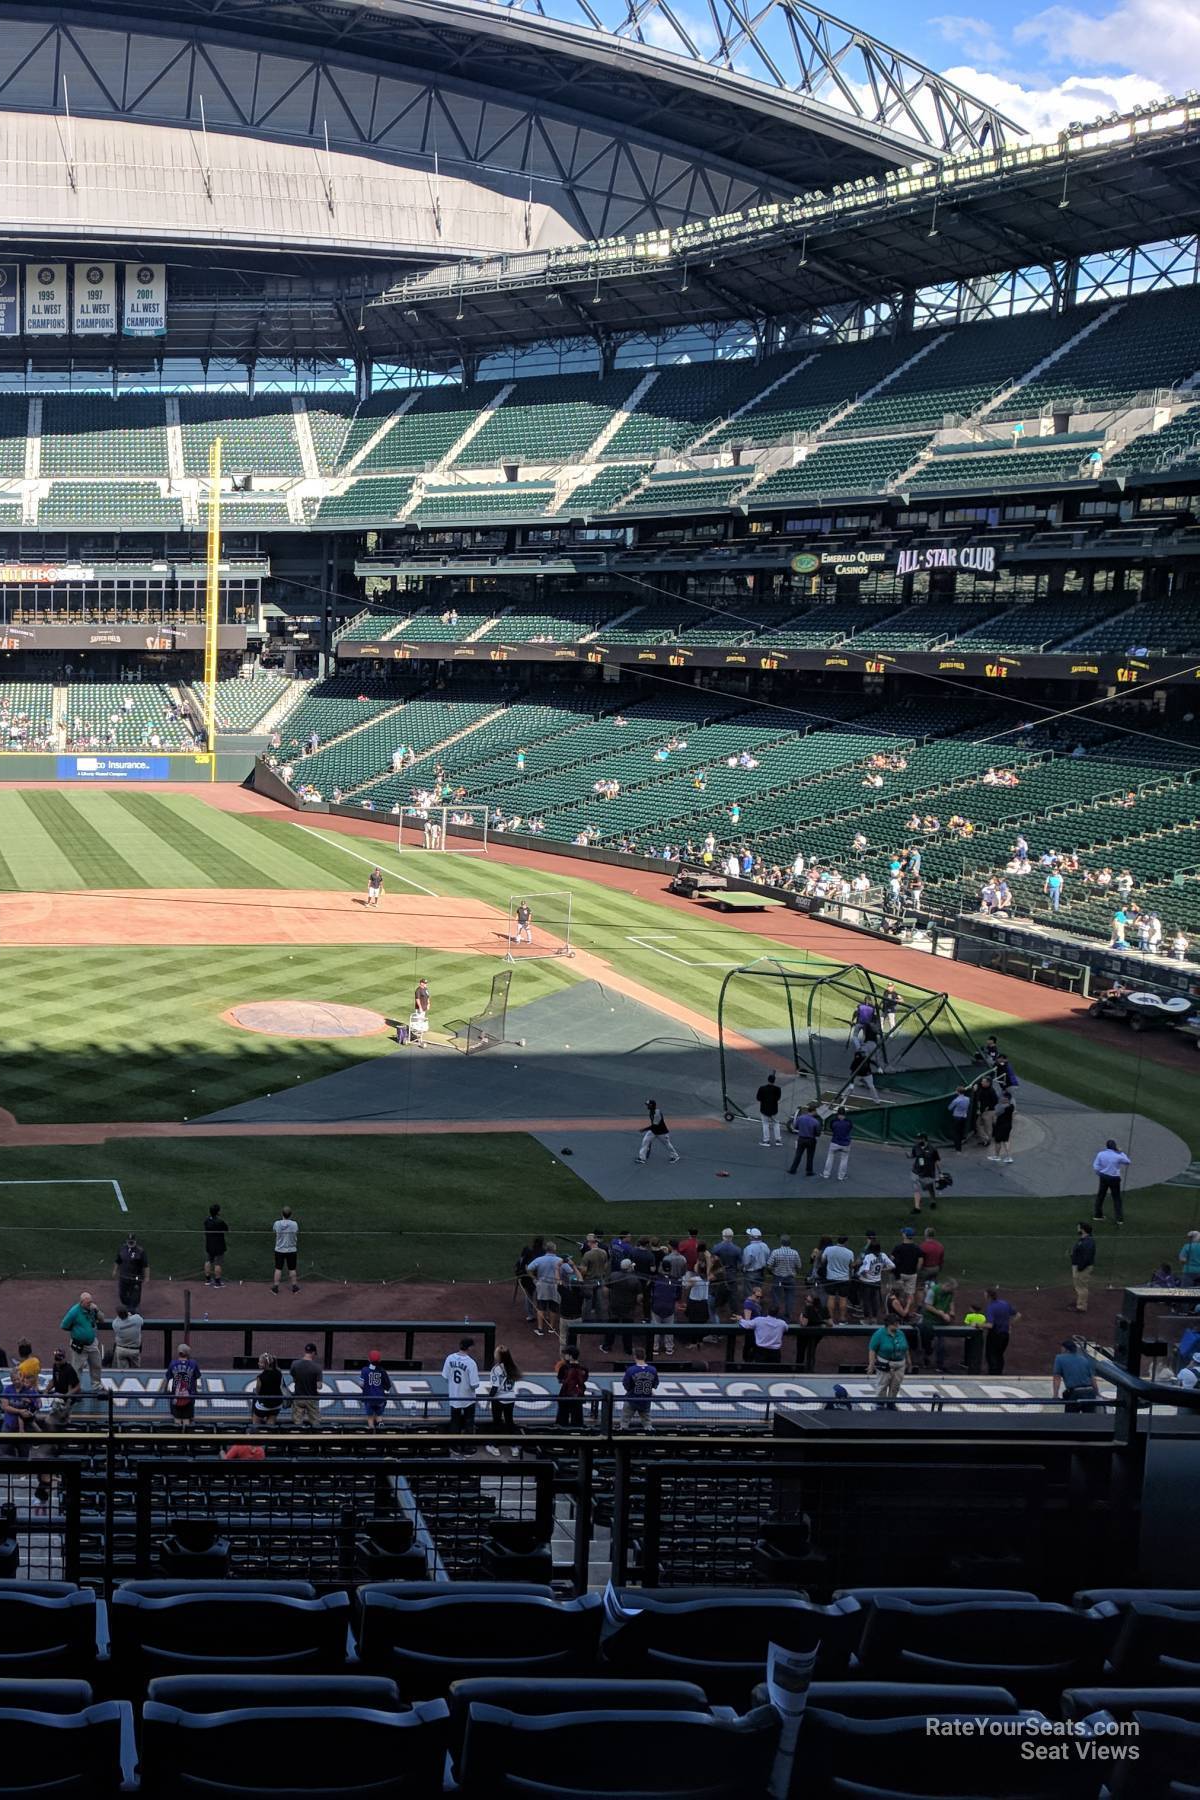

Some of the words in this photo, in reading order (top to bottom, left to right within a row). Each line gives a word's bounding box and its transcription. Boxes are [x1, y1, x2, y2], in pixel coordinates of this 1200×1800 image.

[38, 290, 55, 300] 1995
[88, 290, 103, 300] 1997
[136, 290, 153, 299] 2001
[44, 304, 61, 314] WEST
[92, 304, 110, 314] WEST
[142, 303, 160, 312] WEST
[28, 319, 65, 329] CHAMPIONS
[76, 319, 114, 328] CHAMPIONS
[126, 317, 164, 327] CHAMPIONS
[960, 546, 995, 572] CLUB
[368, 1372, 382, 1386] 15
[453, 1370, 462, 1384] 6
